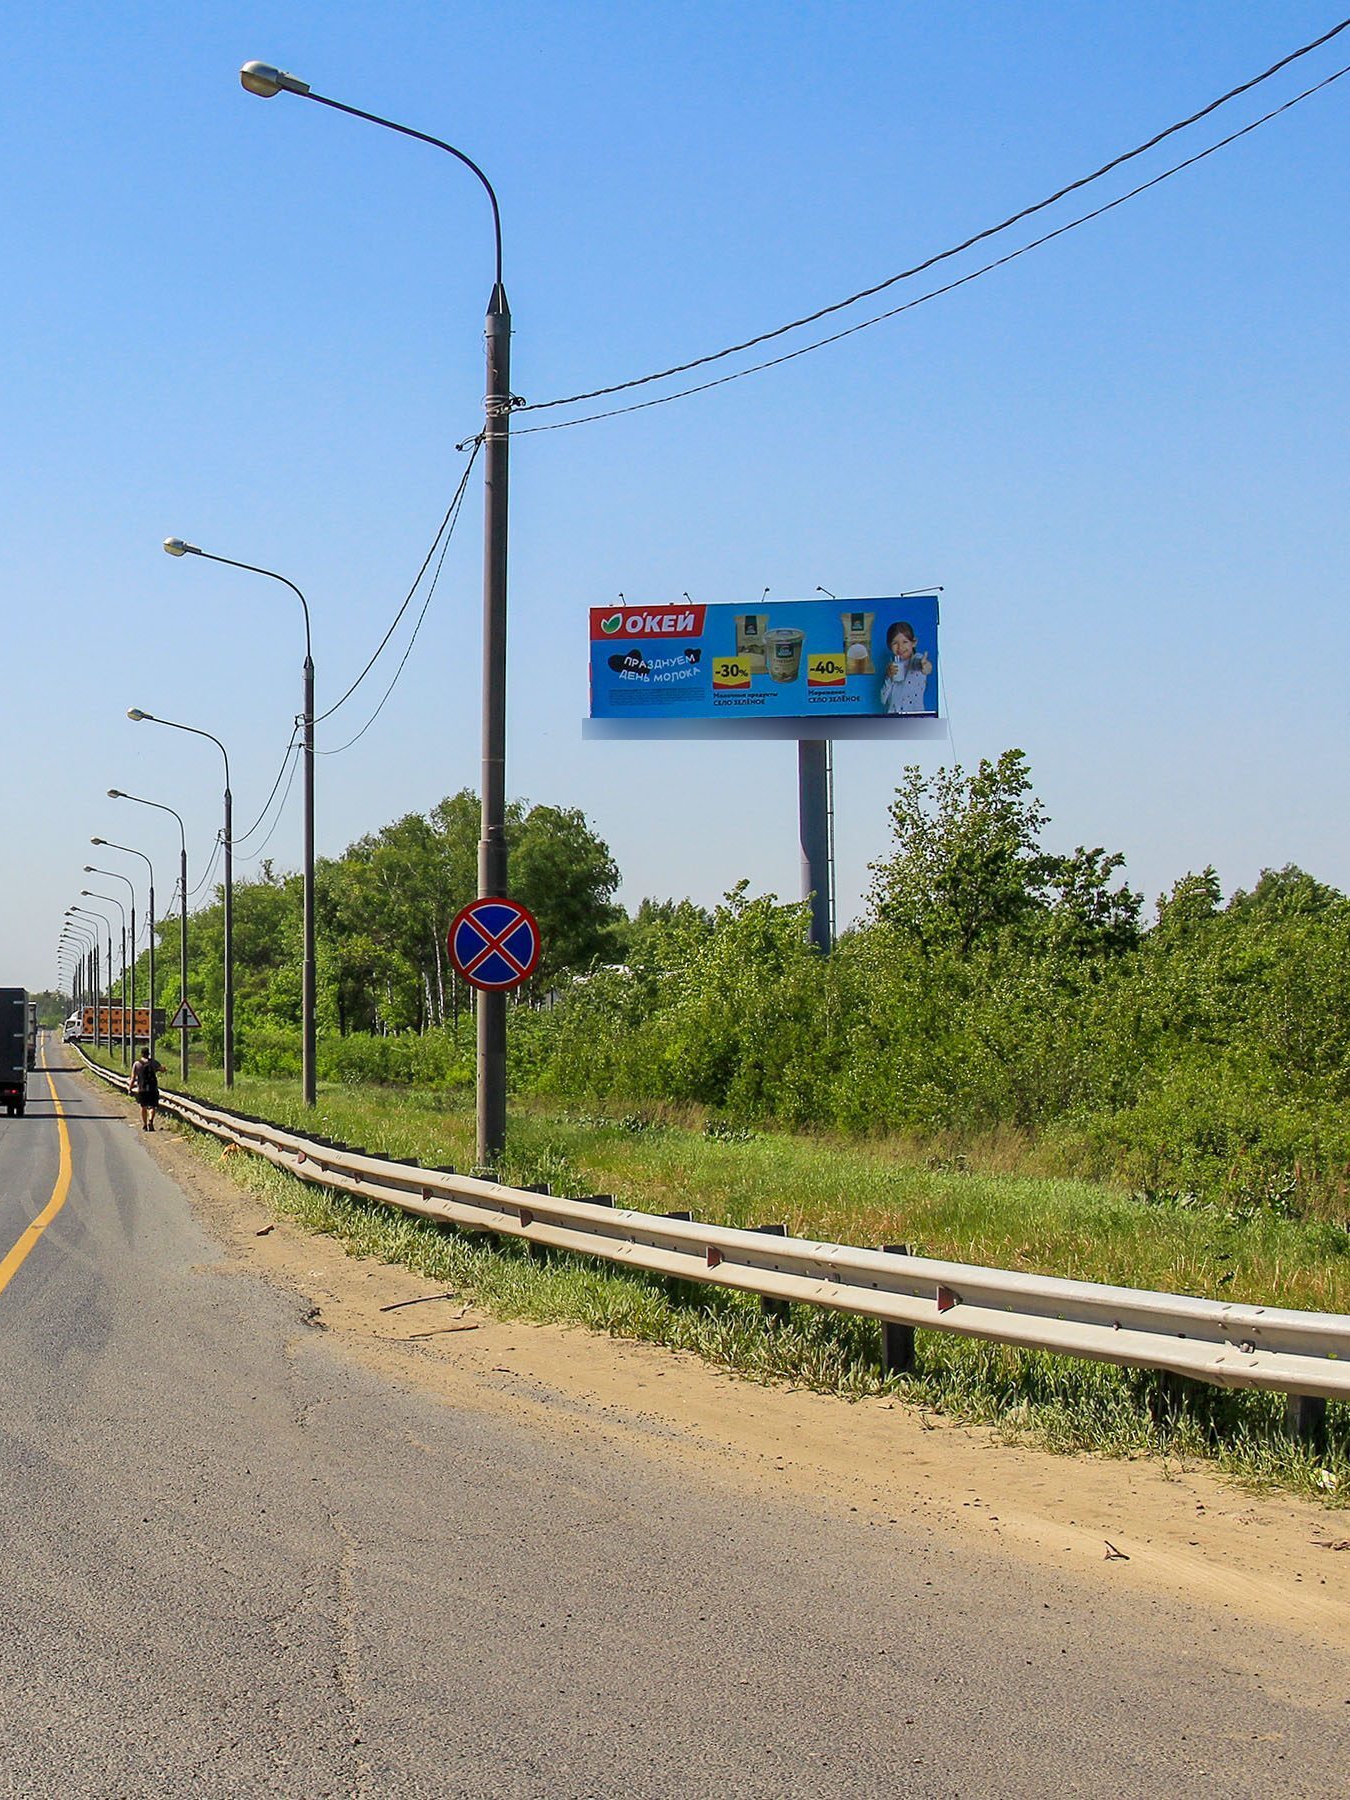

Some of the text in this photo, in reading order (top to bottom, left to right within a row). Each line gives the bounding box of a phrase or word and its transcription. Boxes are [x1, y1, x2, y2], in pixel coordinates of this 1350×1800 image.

[623, 655, 696, 670] ПРАЗДНУЕМ
[809, 660, 845, 675] -40%
[618, 667, 701, 683] ДЕНЬ МОЛОКА
[715, 664, 749, 678] -30%
